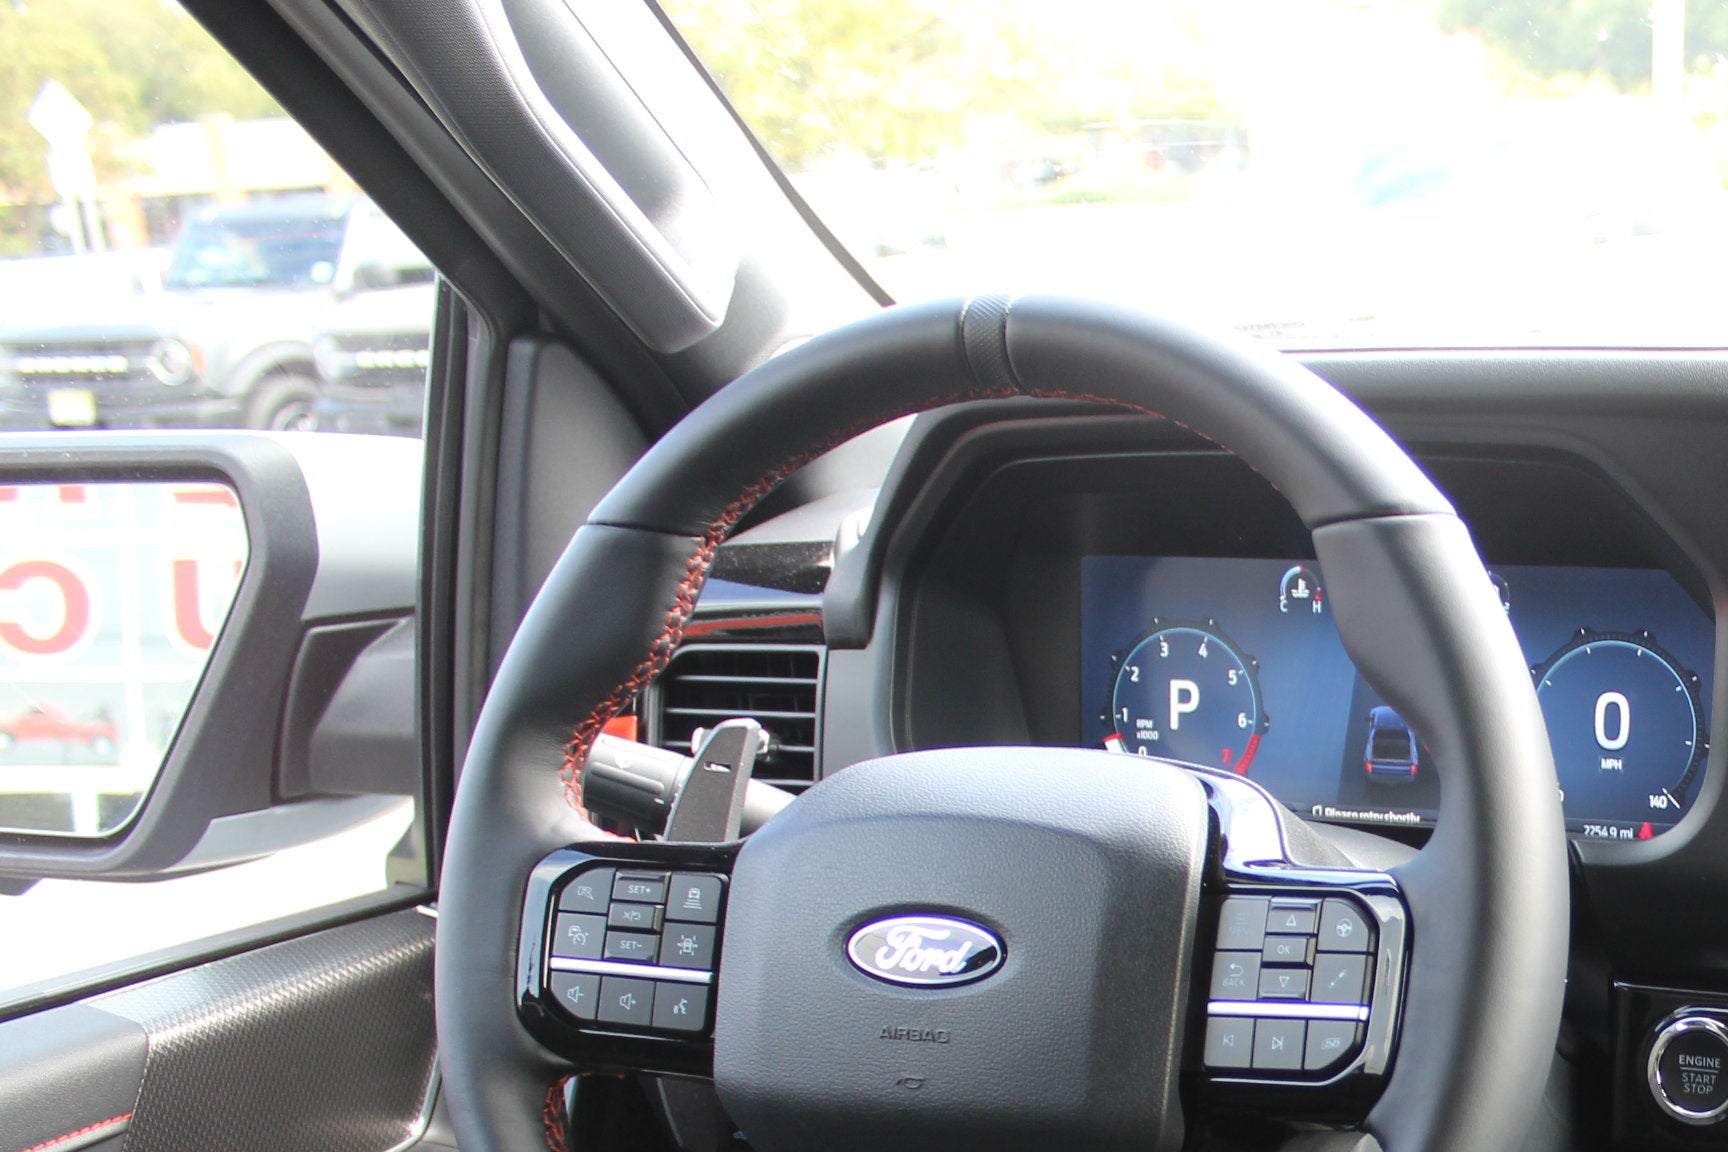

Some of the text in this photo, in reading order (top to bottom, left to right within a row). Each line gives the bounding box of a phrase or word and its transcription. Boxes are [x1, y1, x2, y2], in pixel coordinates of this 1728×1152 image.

[1160, 641, 1169, 657] 3
[1198, 641, 1208, 658] 4
[1130, 666, 1140, 682] 2
[1228, 669, 1237, 685] 5
[1169, 679, 1200, 731] P
[1237, 712, 1247, 728] 6
[1594, 691, 1631, 751] 0
[1601, 758, 1623, 771] MPH
[1649, 794, 1669, 809] 140
[875, 924, 974, 974] Ford
[880, 1025, 950, 1043] AIRBAG
[1678, 1054, 1721, 1068] ENGINE
[1682, 1072, 1716, 1085] START
[1683, 1083, 1713, 1095] STOP
